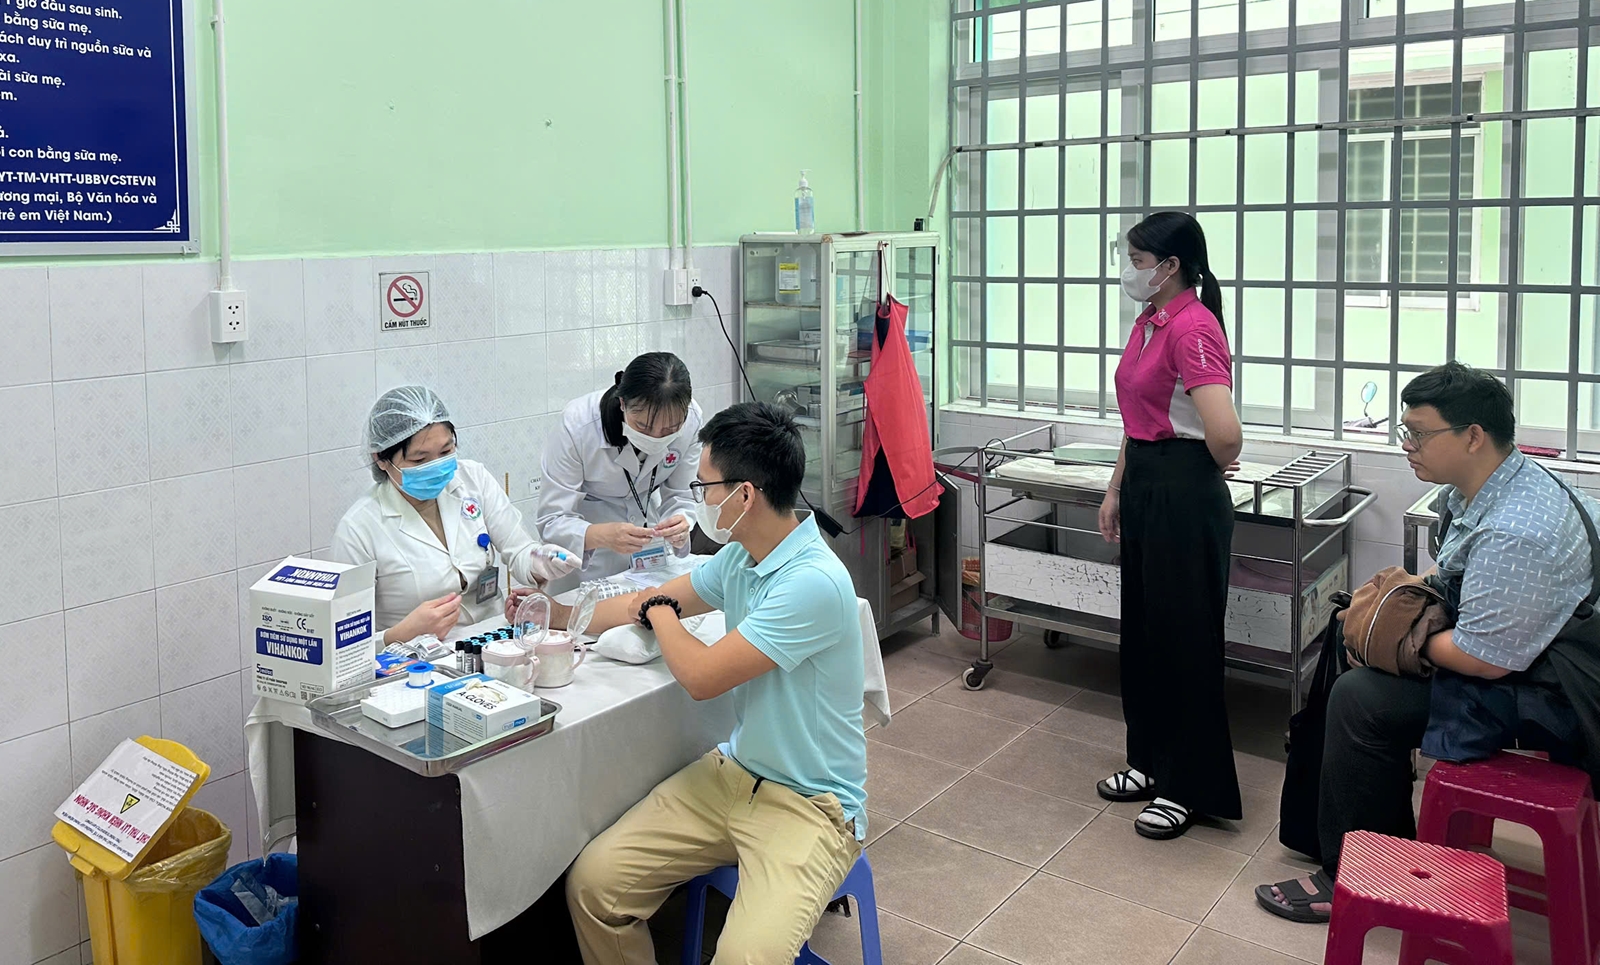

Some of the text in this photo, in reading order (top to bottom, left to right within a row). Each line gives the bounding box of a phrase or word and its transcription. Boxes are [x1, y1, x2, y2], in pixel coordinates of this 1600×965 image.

[40, 0, 66, 12] đầu
[69, 4, 92, 15] sau
[94, 6, 122, 19] sinh.
[3, 11, 92, 36] bằng sữa mẹ.
[27, 35, 51, 50] duy
[54, 37, 67, 49] trì
[71, 39, 110, 54] nguồn
[112, 44, 134, 57] sữa
[137, 47, 152, 58] và
[14, 71, 38, 84] sữa
[41, 75, 66, 88] mẹ.
[0, 91, 18, 101] m.
[8, 148, 34, 159] con
[37, 145, 71, 163] bằng
[74, 149, 96, 161] sữa
[99, 152, 122, 165] mẹ.
[0, 171, 157, 186] YT-TM-VHTT-UBBVCSTEVN
[34, 191, 63, 206] mại,
[67, 191, 83, 206] Bộ
[87, 191, 112, 203] Văn
[115, 191, 139, 204] hóa
[142, 192, 157, 204] và
[19, 211, 41, 221] em
[44, 209, 70, 224] Việt
[73, 210, 113, 224] Nam.)
[290, 568, 338, 583] VIHANKOK
[339, 624, 367, 642] VIHANKOK
[266, 640, 309, 661] VIHANKOK
